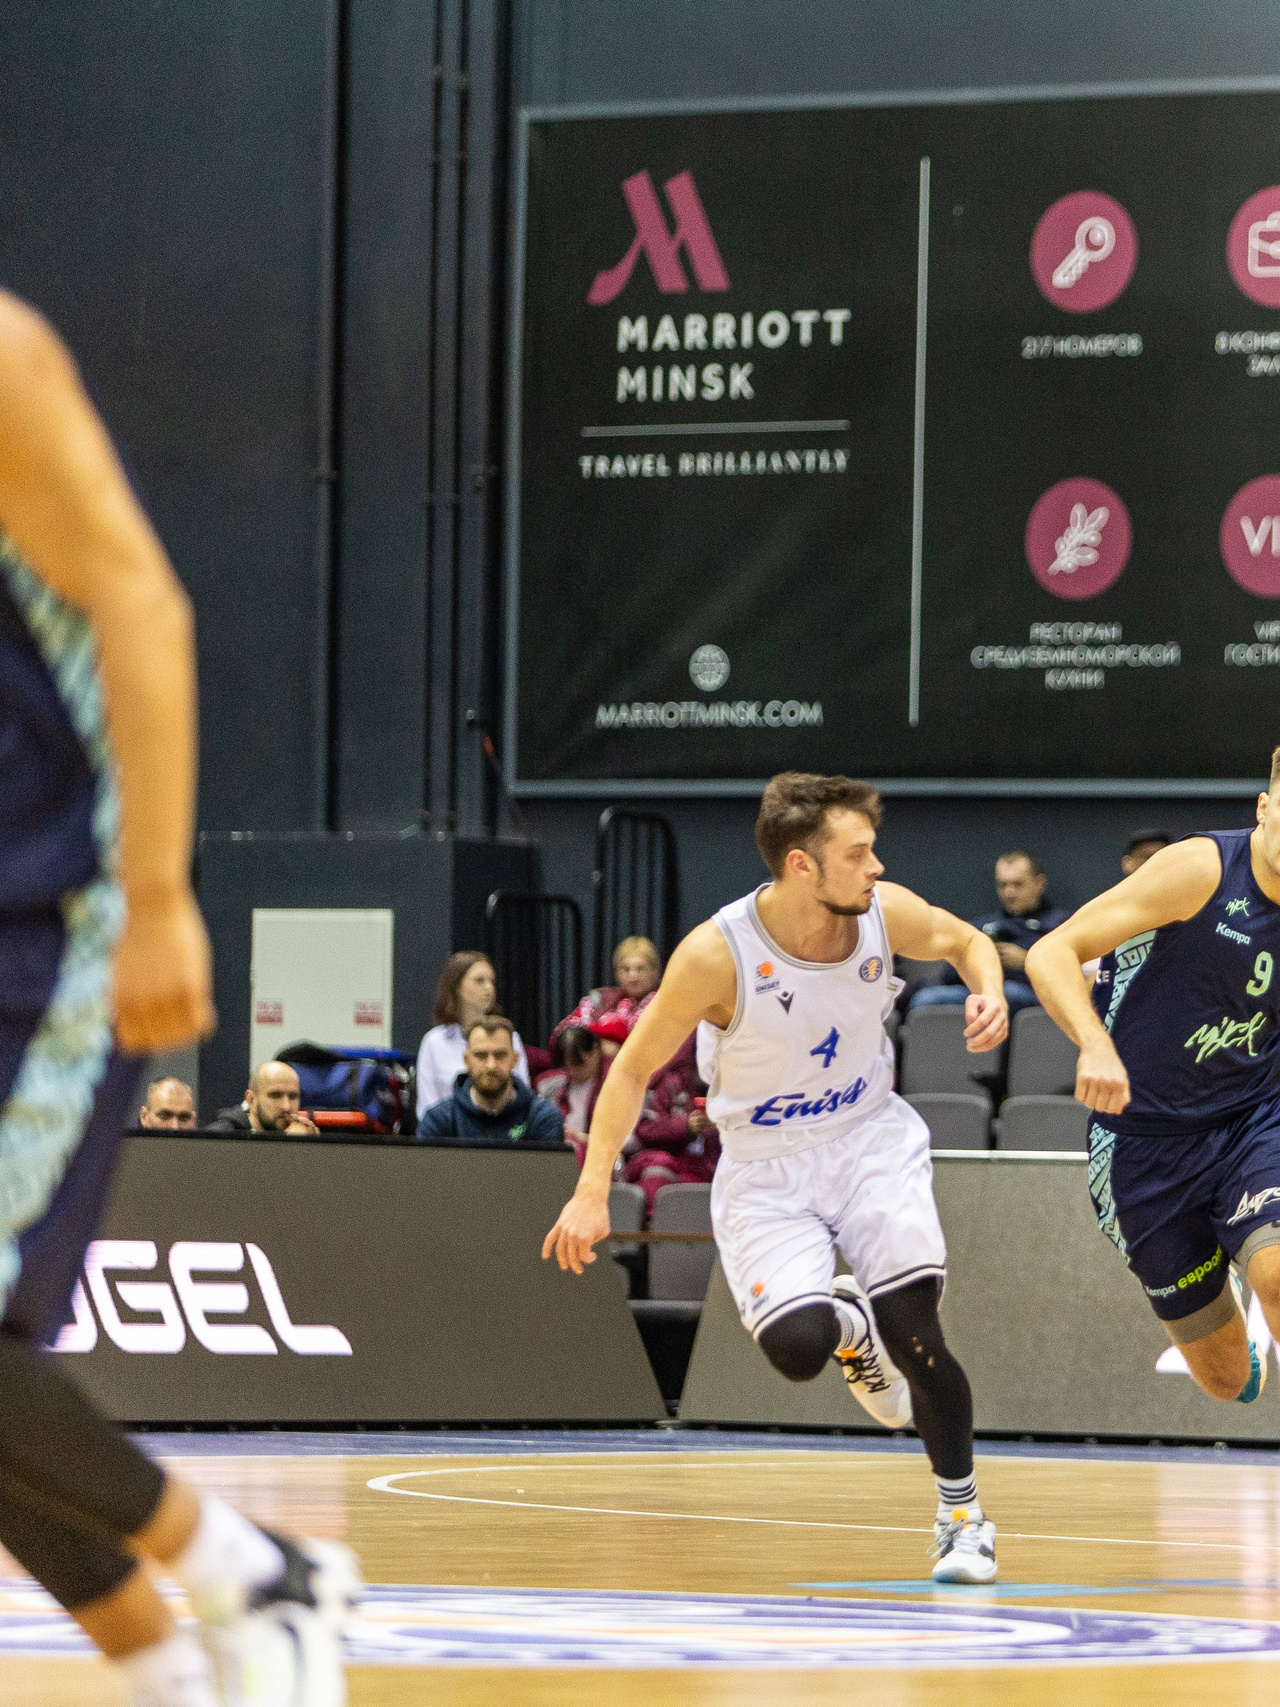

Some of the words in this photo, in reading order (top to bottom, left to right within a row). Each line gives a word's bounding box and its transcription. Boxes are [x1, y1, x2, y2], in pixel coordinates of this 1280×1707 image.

[616, 308, 852, 353] MARRIOTT
[616, 362, 755, 402] MINSK
[579, 453, 672, 479] TRAVEL
[678, 449, 849, 477] BRILLIANTLY
[595, 700, 824, 729] MARRIOTTMINSK.COM
[1215, 922, 1252, 946] Kempa
[1246, 951, 1275, 997] 9
[810, 1026, 840, 1069] 4
[50, 1240, 353, 1356] GEL
